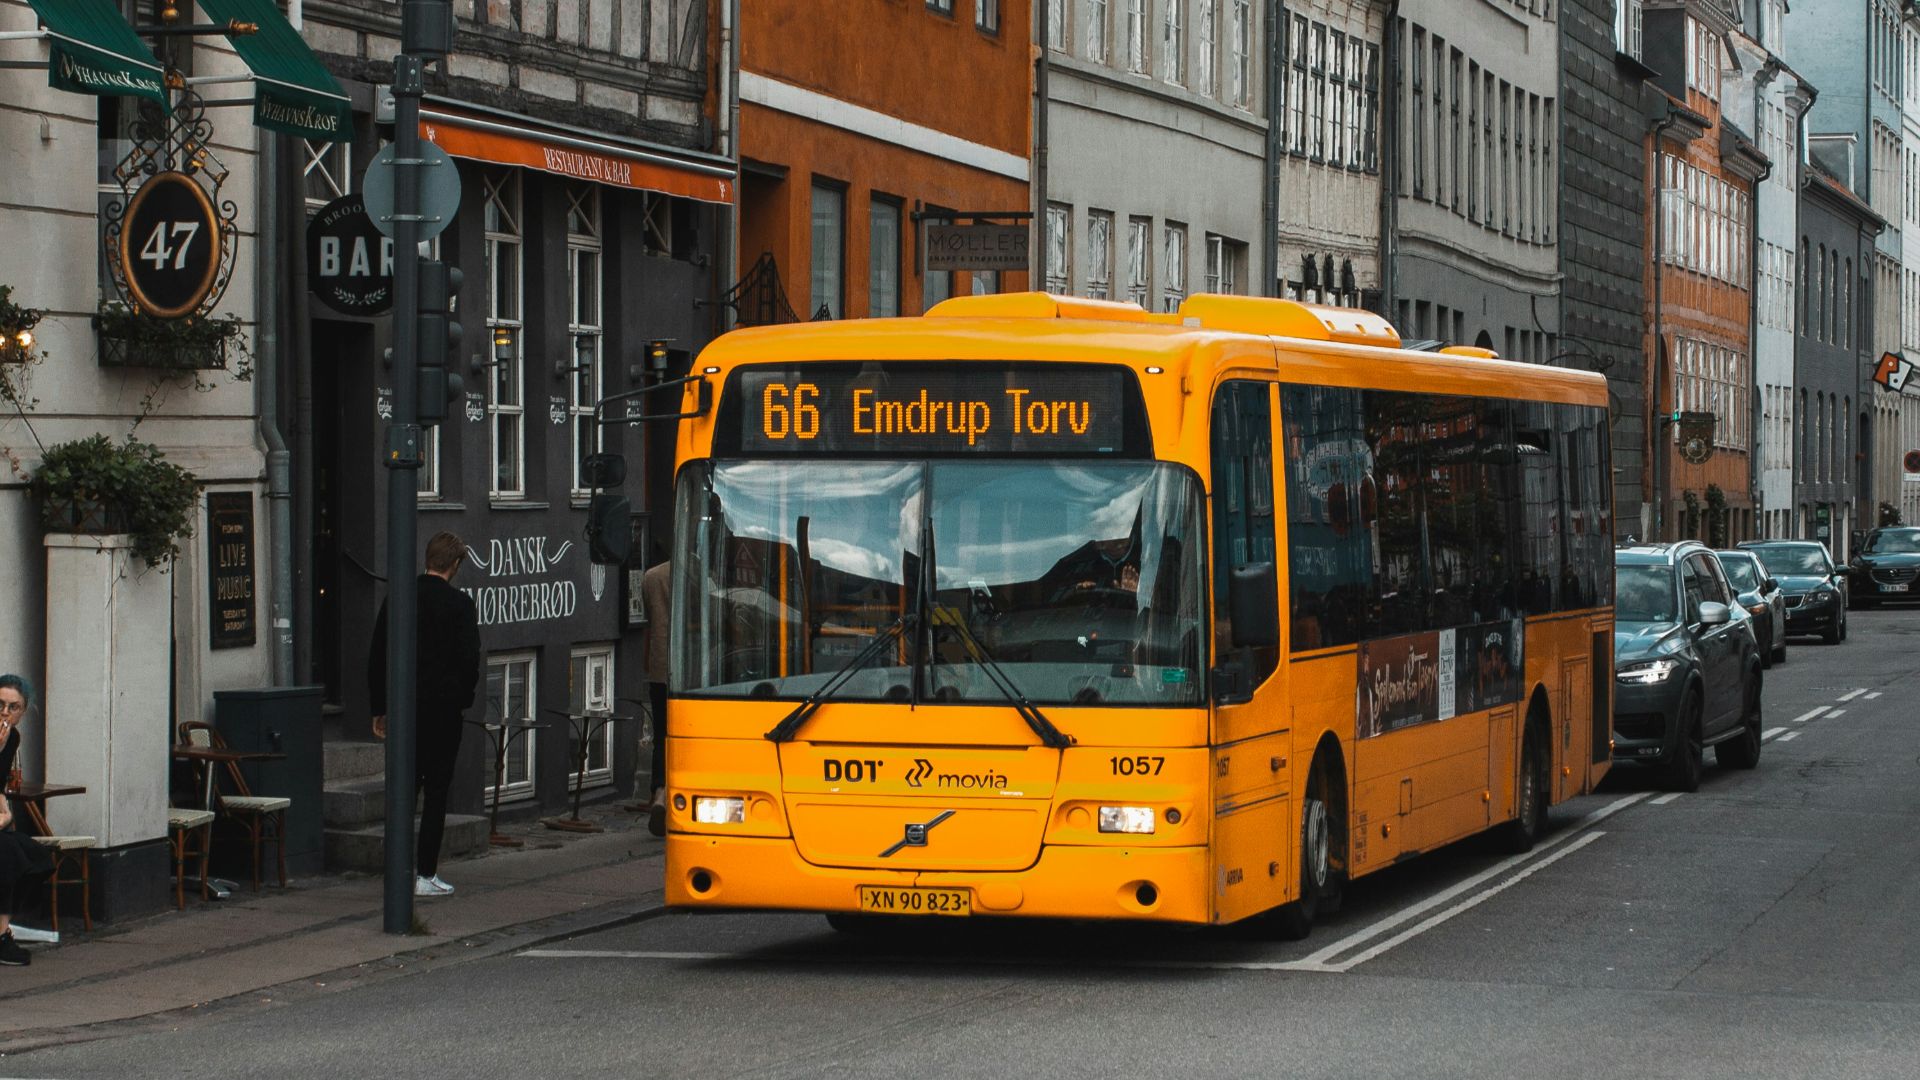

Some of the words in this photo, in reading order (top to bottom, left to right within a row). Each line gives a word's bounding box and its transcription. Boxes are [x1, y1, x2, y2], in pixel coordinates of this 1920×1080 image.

[544, 147, 603, 178] RESTAURANT
[604, 160, 612, 180] &
[613, 161, 631, 185] BAR
[323, 203, 367, 226] BROO
[140, 221, 200, 271] 47
[928, 233, 1028, 252] MØLLER
[320, 236, 394, 277] BAR
[763, 383, 819, 439] 66
[853, 389, 990, 446] Emdrup
[1005, 389, 1089, 434] Torv
[219, 543, 247, 567] LIVE
[490, 536, 548, 577] DANSK
[217, 575, 252, 601] MUSIC
[460, 580, 576, 625] MØRREBRØD
[824, 759, 883, 783] DOT
[1110, 756, 1165, 776] 1057
[1216, 757, 1230, 778] 1057
[938, 769, 1008, 789] movia
[870, 890, 894, 908] XN
[900, 892, 922, 909] 90
[927, 893, 962, 911] 823
